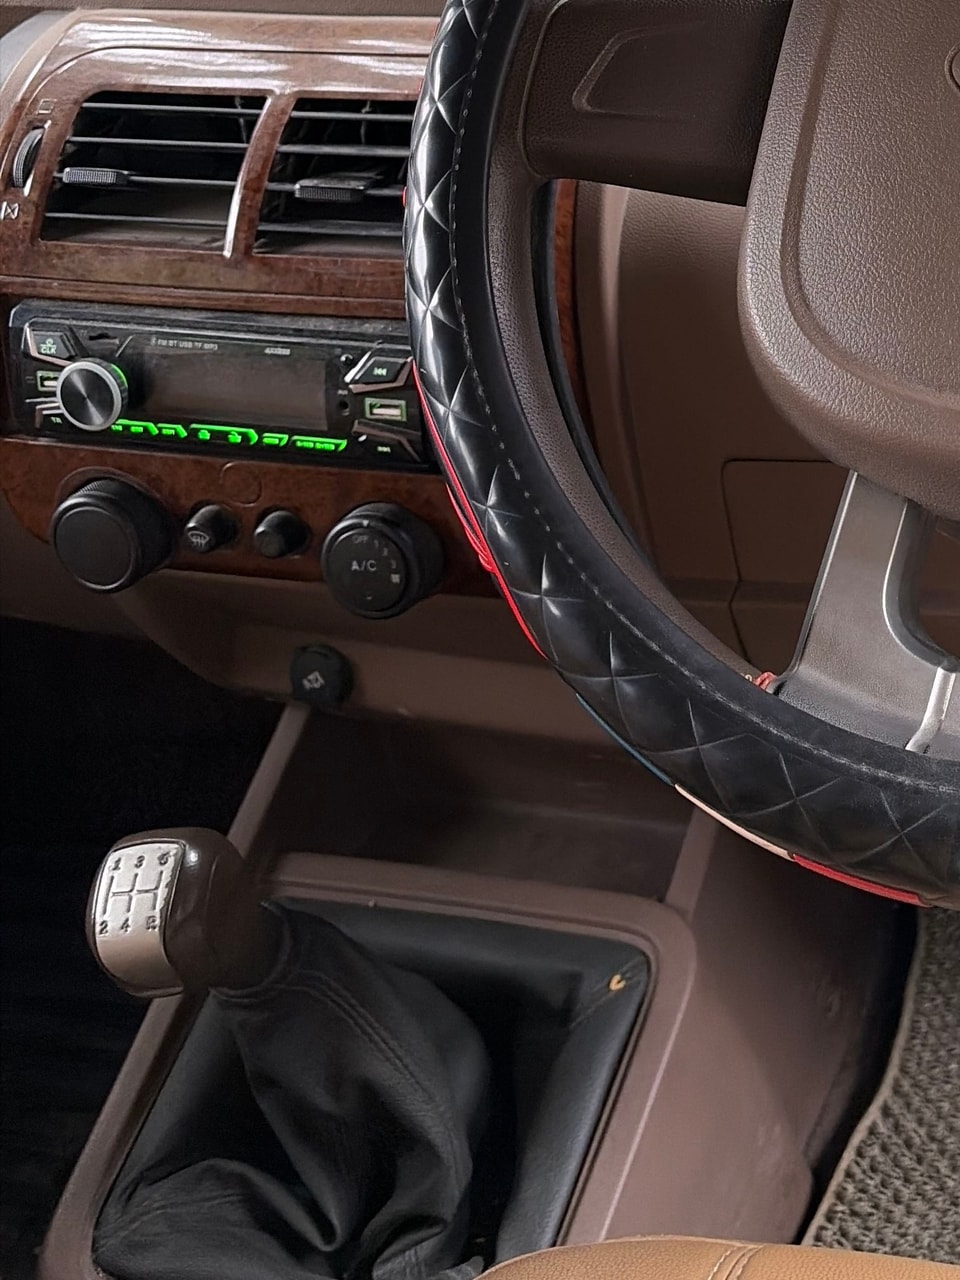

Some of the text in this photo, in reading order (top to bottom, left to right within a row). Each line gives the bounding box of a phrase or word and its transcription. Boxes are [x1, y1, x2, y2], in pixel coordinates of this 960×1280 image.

[40, 346, 57, 354] CLK
[352, 535, 369, 544] OFF
[351, 560, 377, 571] A/C
[110, 857, 121, 870] 1
[135, 855, 145, 868] 3
[99, 915, 158, 935] 2 4 R
